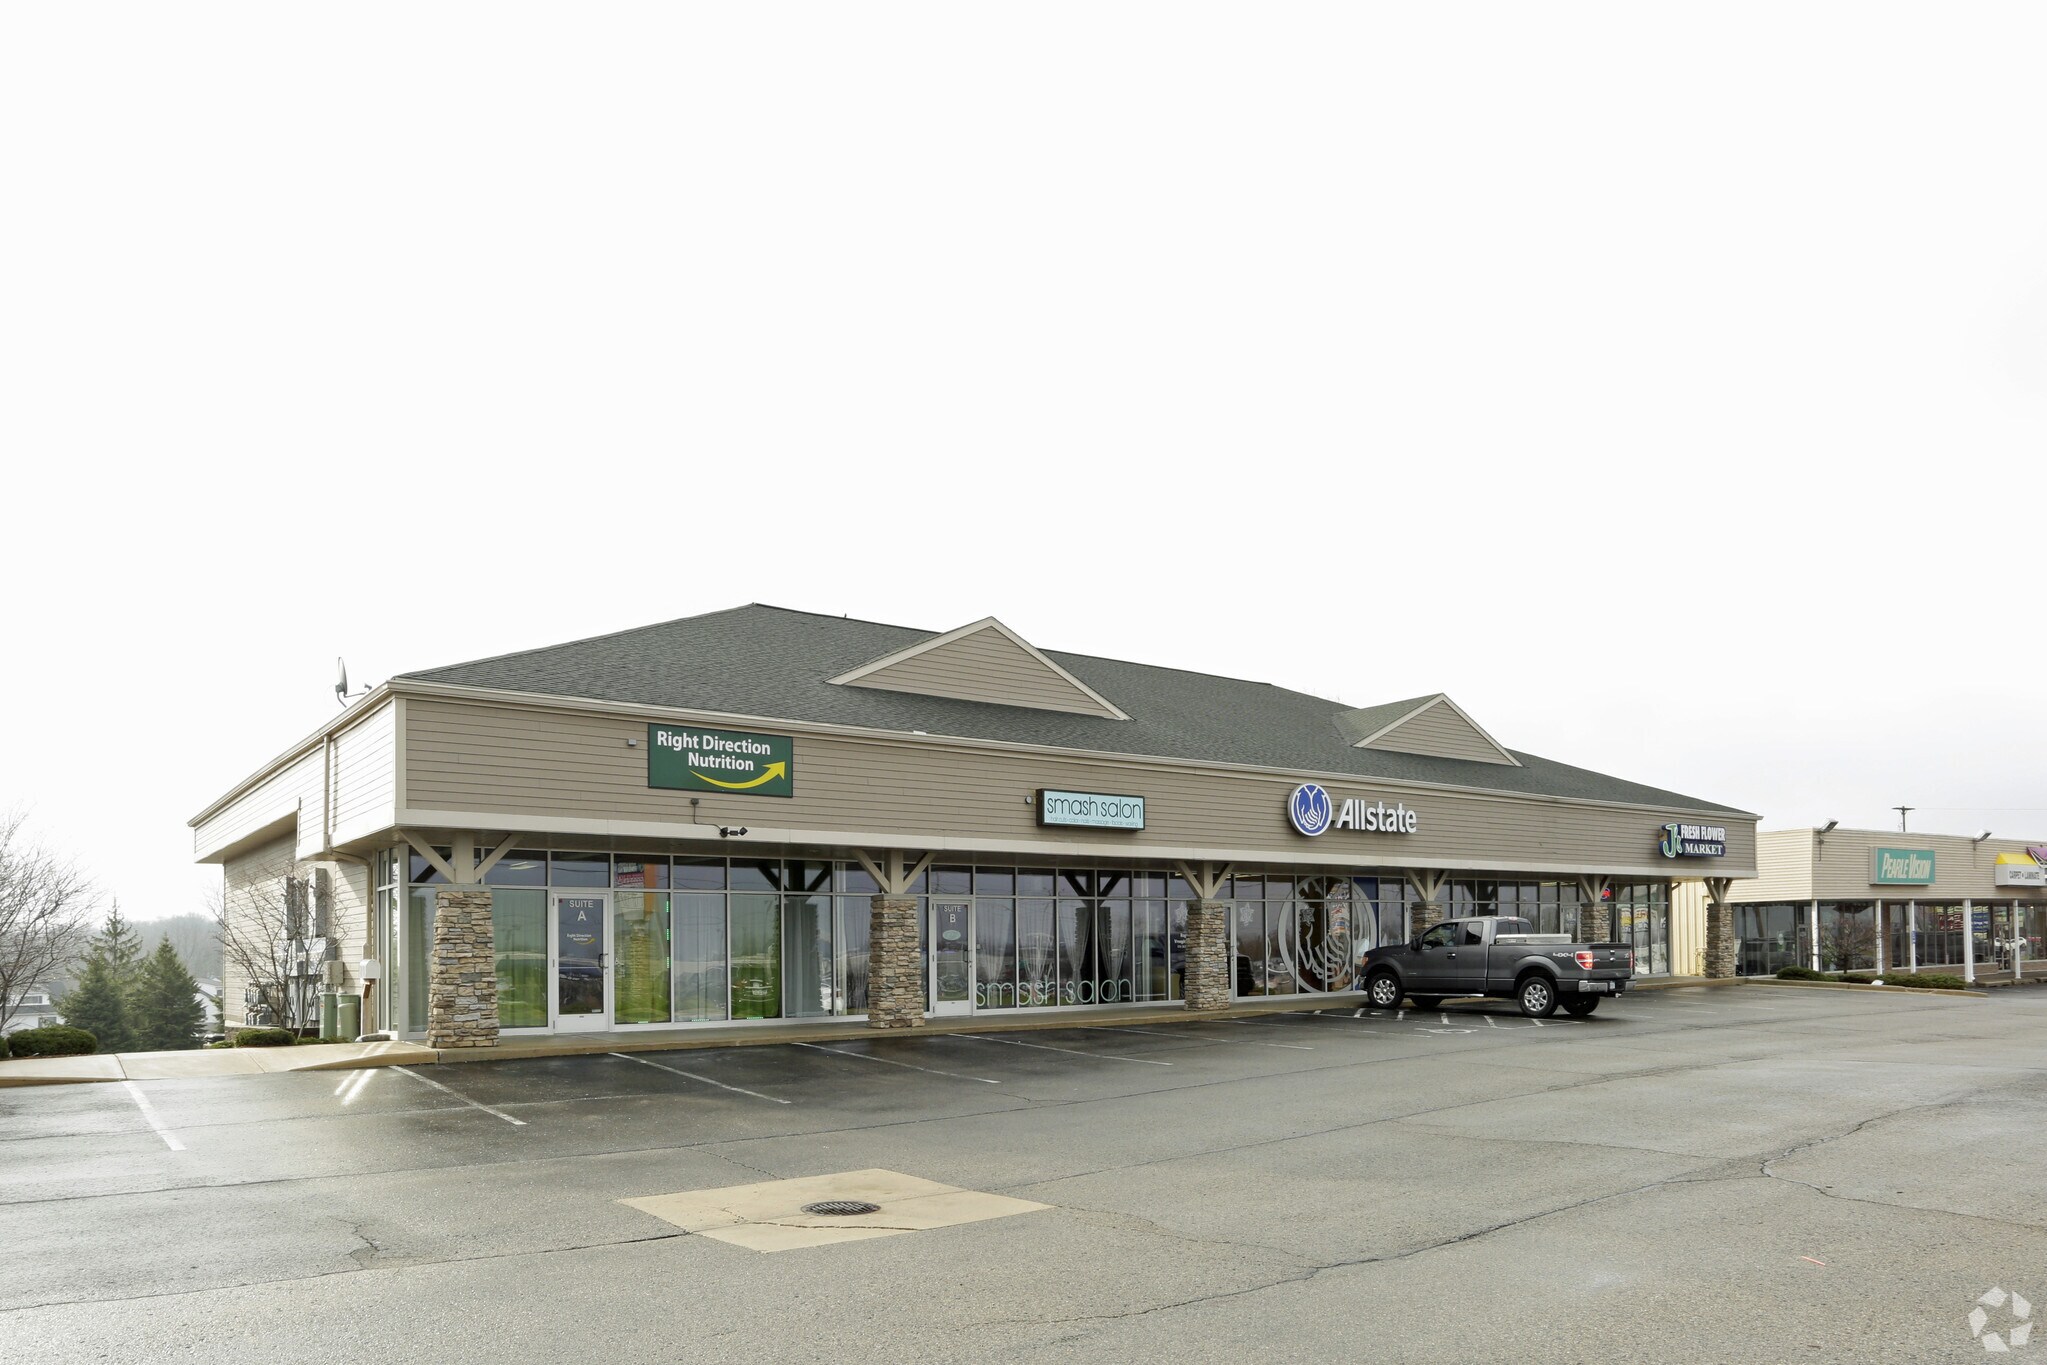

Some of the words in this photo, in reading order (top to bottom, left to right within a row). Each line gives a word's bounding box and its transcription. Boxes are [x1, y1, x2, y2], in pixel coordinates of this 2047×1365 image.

[657, 730, 699, 751] Right
[702, 735, 771, 756] Direction
[688, 752, 754, 771] Nutrition
[1047, 796, 1098, 816] smash
[1101, 798, 1141, 819] salon
[1335, 798, 1417, 833] Allstate
[1681, 824, 1701, 840] FRESH
[1701, 826, 1726, 841] FLOWER
[1685, 843, 1723, 855] MARKET
[569, 899, 594, 908] SUITE
[577, 910, 587, 921] A
[949, 913, 956, 923] B
[1065, 978, 1132, 1004] saon
